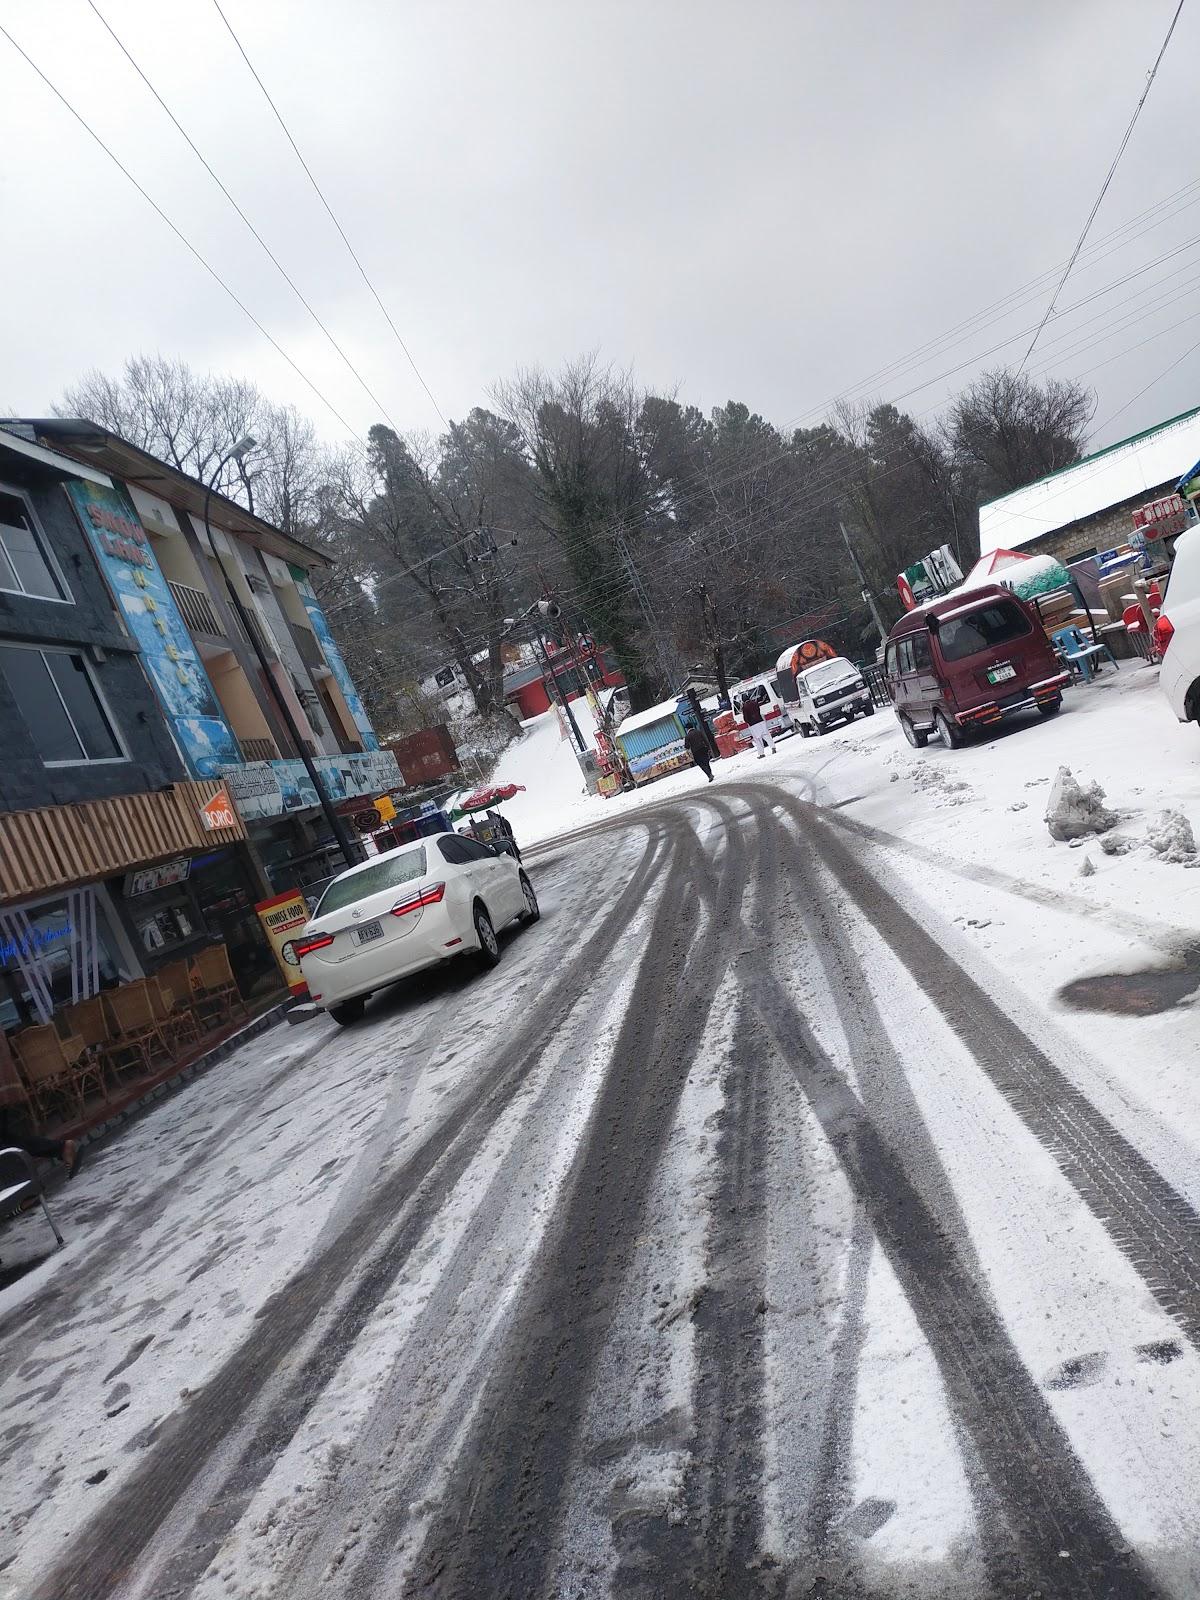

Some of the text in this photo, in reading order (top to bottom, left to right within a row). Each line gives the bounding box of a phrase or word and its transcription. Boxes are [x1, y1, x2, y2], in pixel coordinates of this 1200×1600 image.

[133, 569, 189, 686] HOTEL
[265, 904, 304, 927] CHINESE FOOD
